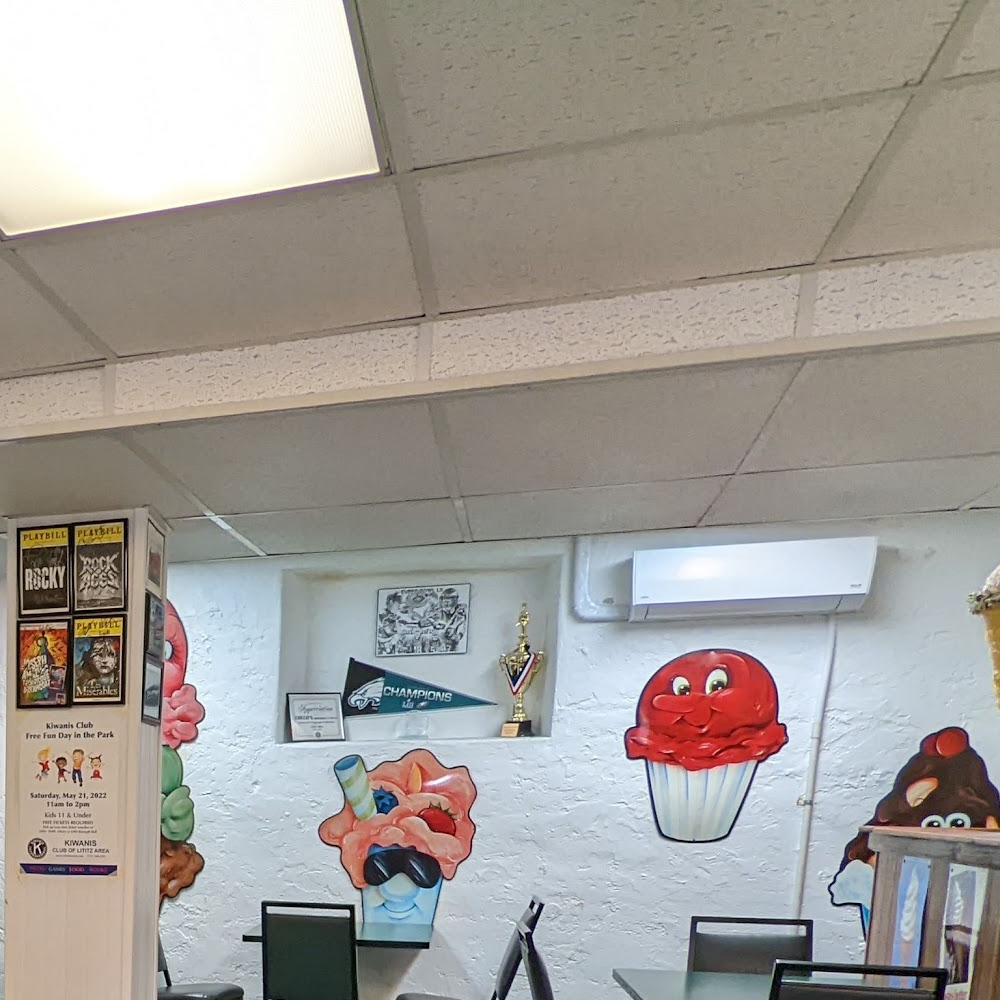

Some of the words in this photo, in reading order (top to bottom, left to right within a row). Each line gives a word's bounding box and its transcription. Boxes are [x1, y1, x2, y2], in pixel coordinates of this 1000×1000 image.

[23, 531, 67, 541] PLAYBILL
[77, 526, 122, 537] PLAYBILL
[79, 552, 119, 576] ROCK
[24, 565, 66, 591] ROCKY
[76, 620, 121, 630] PLAYBILL
[383, 686, 453, 702] CHAMPIONS
[46, 721, 74, 730] Kiwanis
[76, 721, 94, 729] Club
[58, 732, 72, 740] Day
[30, 792, 61, 800] Saturday,
[62, 792, 76, 800] May
[75, 801, 90, 809] 2pm
[64, 839, 97, 847] KIWANIS
